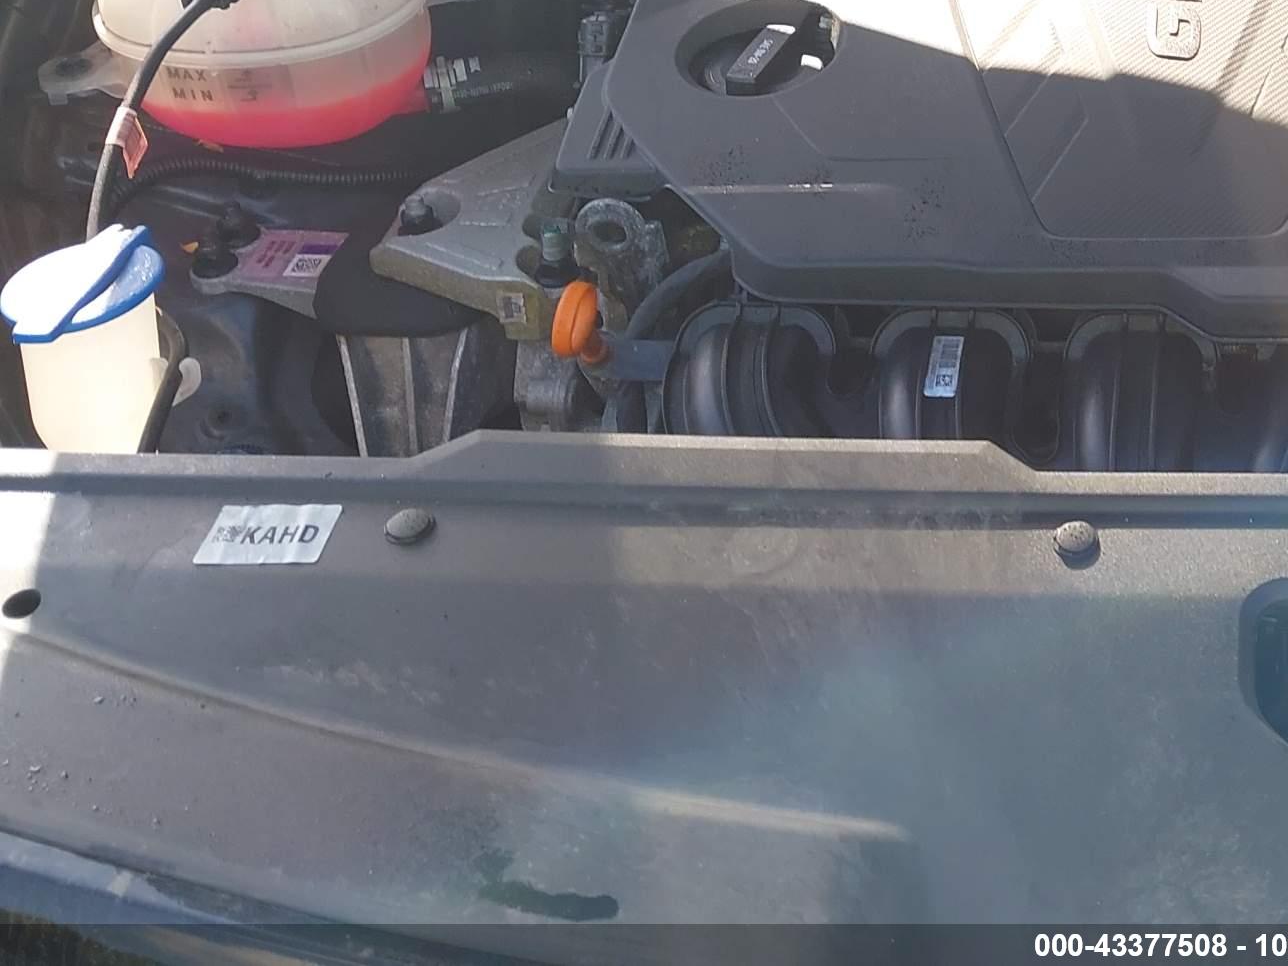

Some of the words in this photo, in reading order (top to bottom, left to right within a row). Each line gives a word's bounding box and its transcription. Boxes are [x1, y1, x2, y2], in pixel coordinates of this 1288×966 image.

[166, 67, 208, 82] MAX
[171, 87, 214, 102] MIN
[239, 524, 320, 545] KAHD
